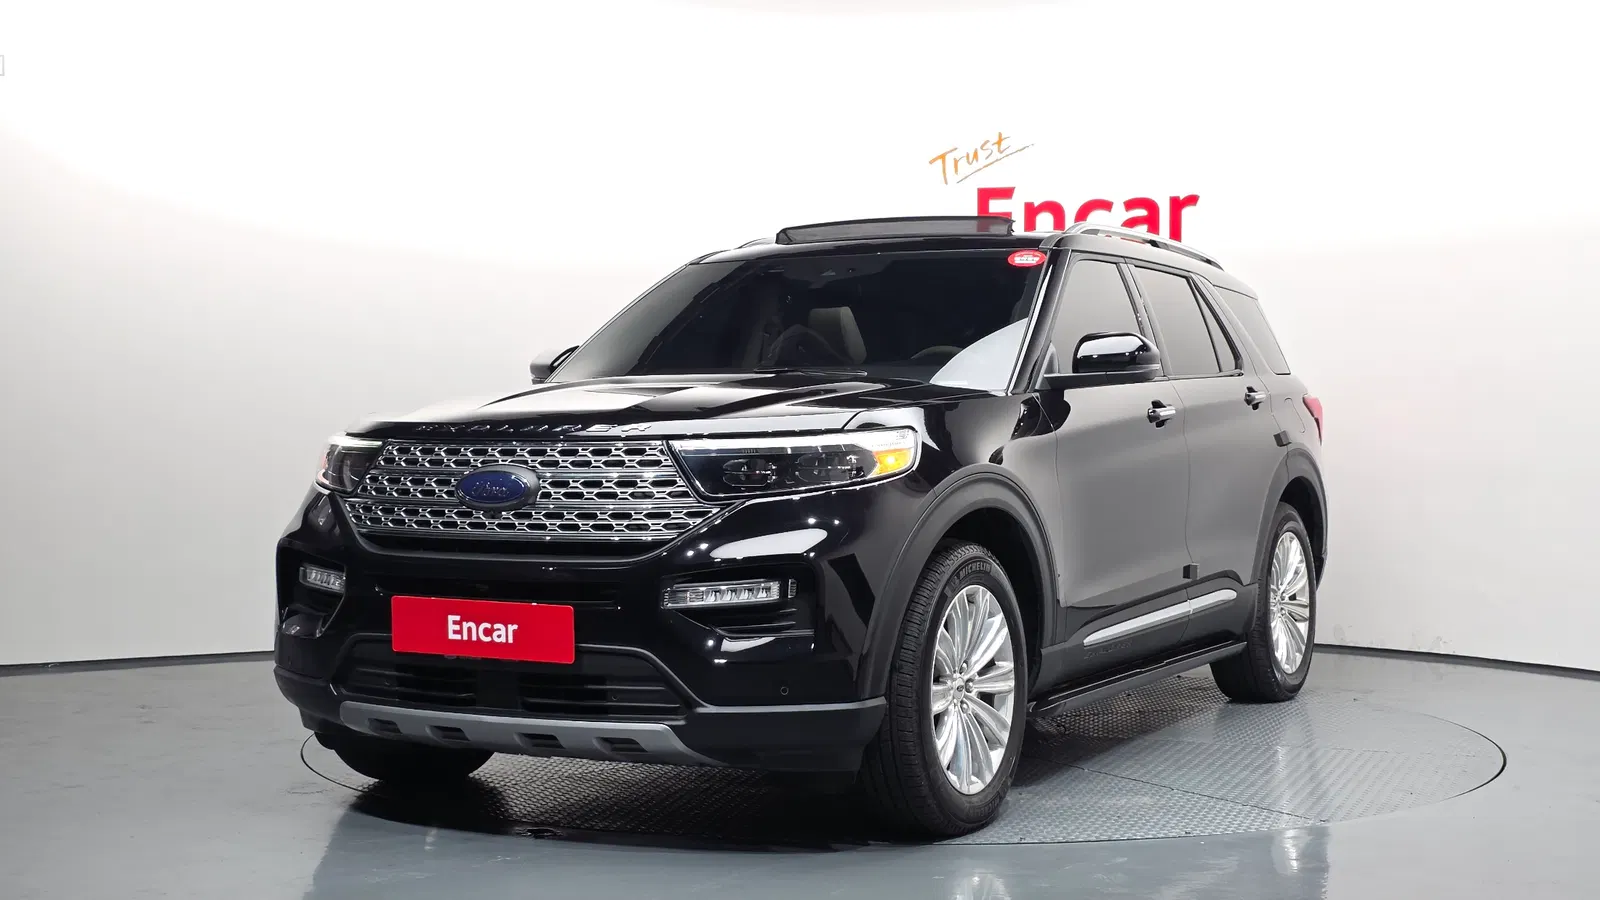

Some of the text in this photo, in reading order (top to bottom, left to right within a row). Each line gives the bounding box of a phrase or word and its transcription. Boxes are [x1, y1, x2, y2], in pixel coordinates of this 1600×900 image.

[929, 132, 1011, 185] Trust
[977, 187, 1200, 243] Encar
[959, 561, 992, 580] MICHELIN
[447, 615, 518, 643] Encar
